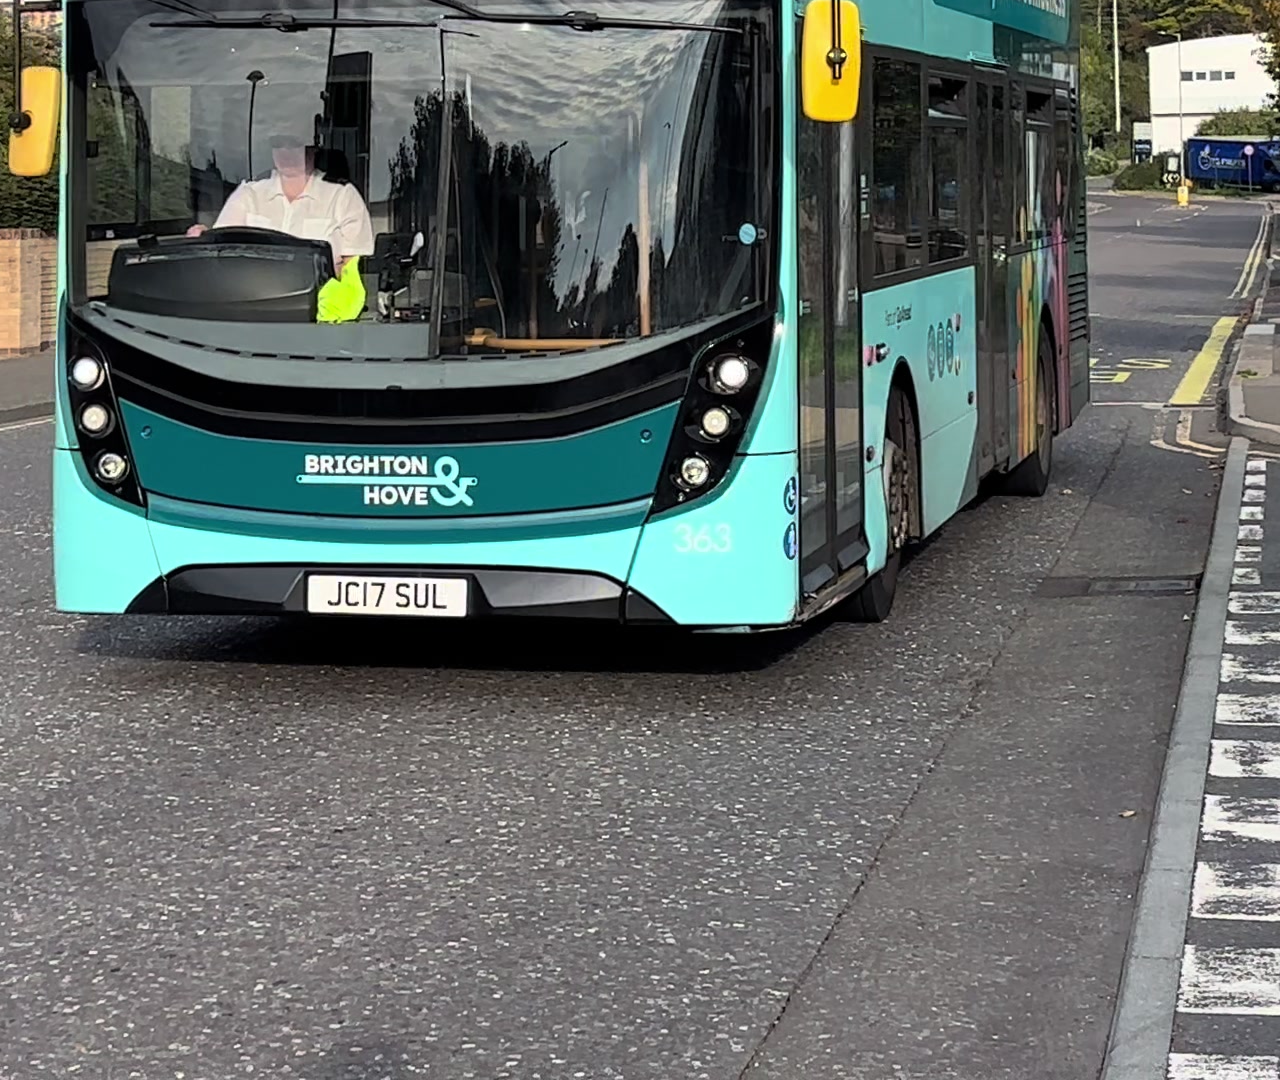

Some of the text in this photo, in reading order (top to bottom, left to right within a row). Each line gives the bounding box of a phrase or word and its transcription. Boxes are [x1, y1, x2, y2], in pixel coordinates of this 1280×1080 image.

[304, 454, 428, 475] BRIGHTON
[363, 485, 429, 506] HOVE
[673, 522, 732, 554] 363
[327, 581, 448, 610] JC17 SUL
